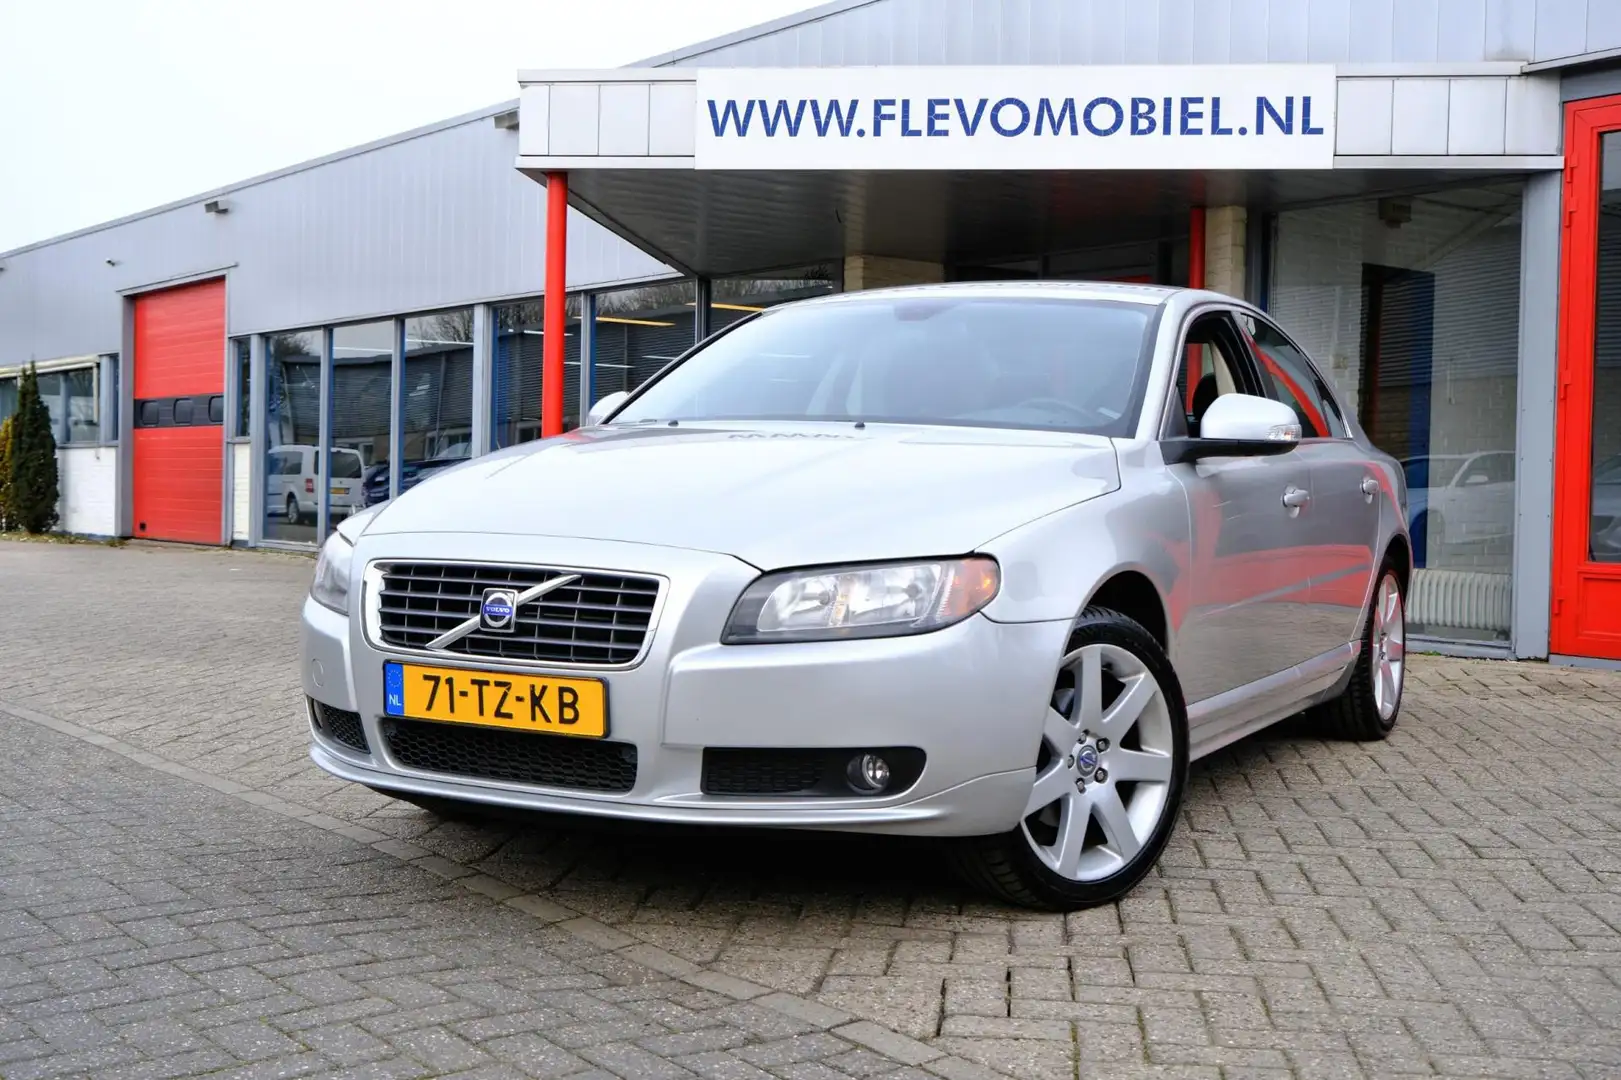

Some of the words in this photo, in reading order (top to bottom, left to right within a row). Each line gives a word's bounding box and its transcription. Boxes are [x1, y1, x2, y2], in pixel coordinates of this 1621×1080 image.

[707, 96, 1324, 138] WWW.FLEVOMOBIEL.NL
[389, 694, 402, 706] NL
[422, 674, 580, 725] 71-TZ-KB
